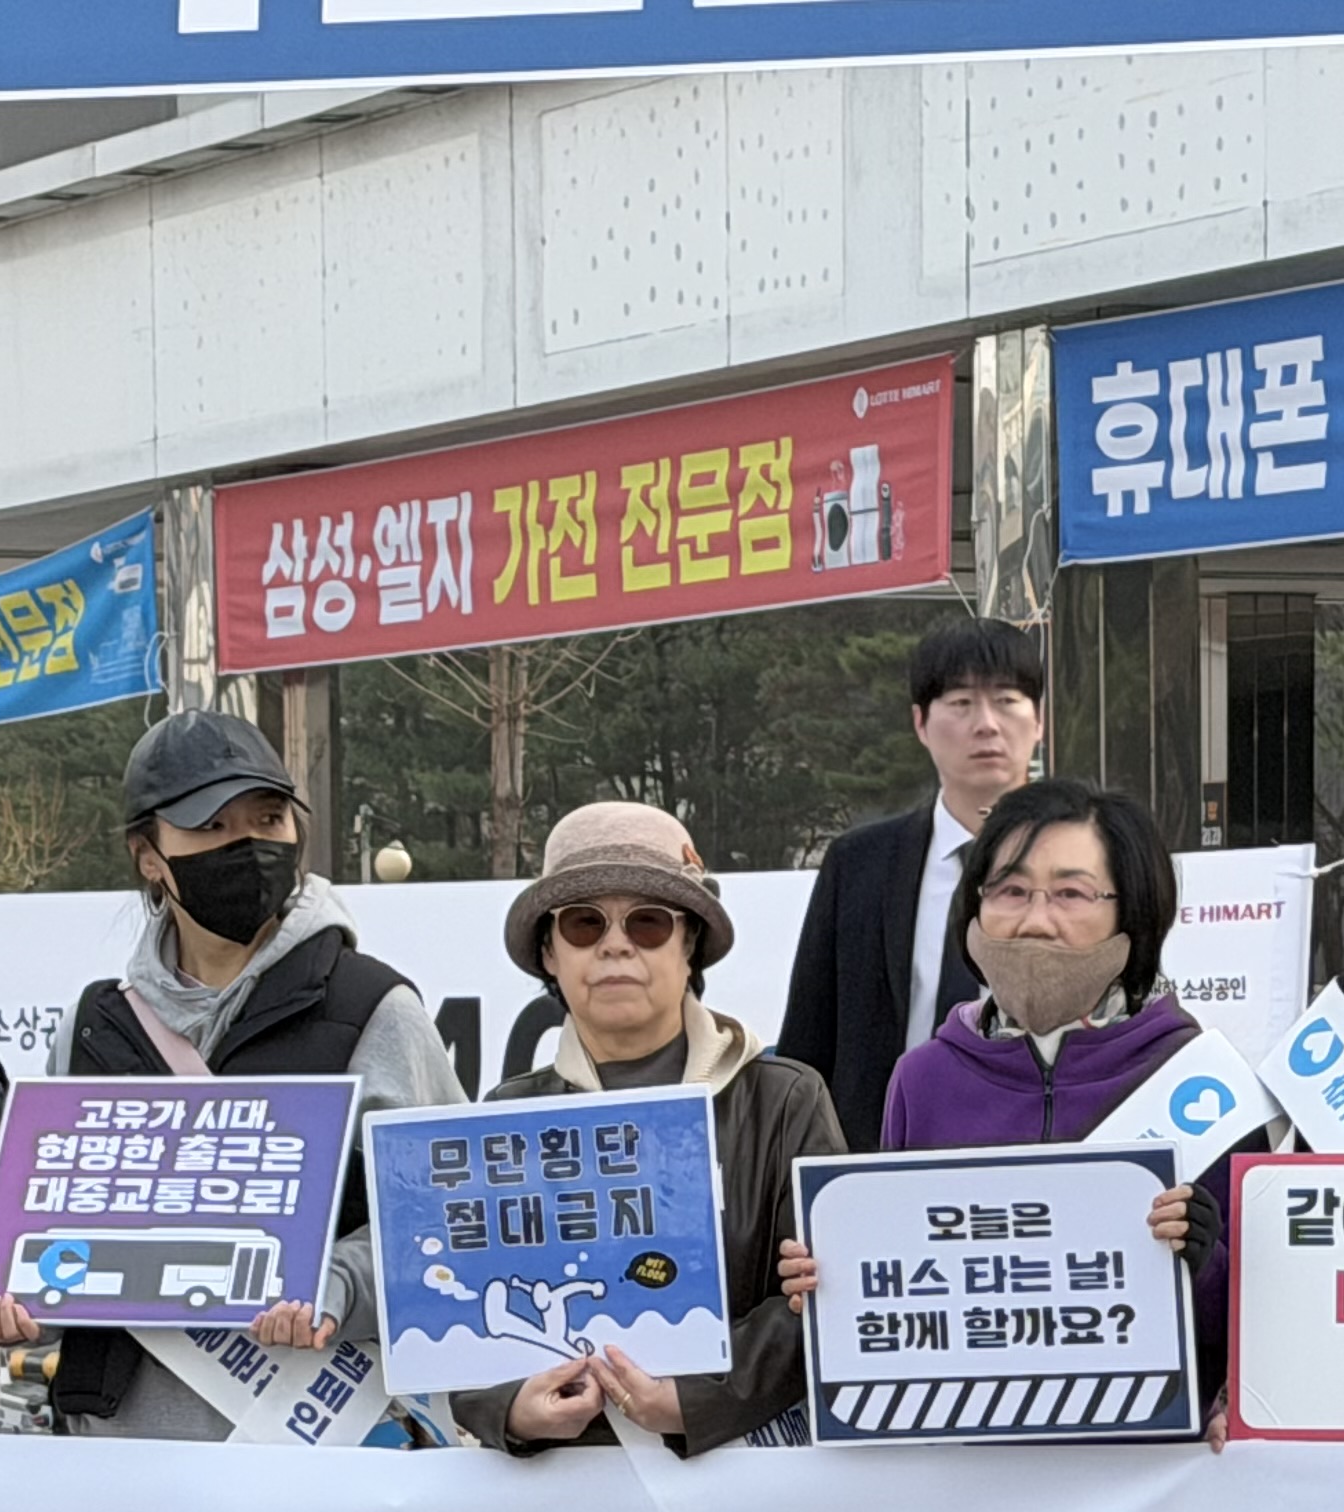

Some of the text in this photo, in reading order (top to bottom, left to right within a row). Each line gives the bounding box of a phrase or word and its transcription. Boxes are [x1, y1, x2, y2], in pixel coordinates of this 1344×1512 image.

[1092, 336, 1330, 517] 휴대폰
[492, 470, 598, 606] 가전
[620, 436, 793, 594] 전문점
[1199, 901, 1286, 923] HIMART
[1181, 976, 1247, 1001] 소상공인
[74, 1099, 277, 1133] 고유가 시대,
[35, 1133, 306, 1172] 현명한 출근은
[428, 1122, 642, 1191] 무단횡단
[23, 1176, 301, 1216] 대중교통으로!
[443, 1184, 657, 1252] 절대금지
[926, 1202, 1052, 1241] 오늘은
[860, 1251, 1125, 1299] 버스 타는 날!
[856, 1303, 1136, 1353] 함께 할까요?
[285, 1339, 374, 1446] 캠페인
